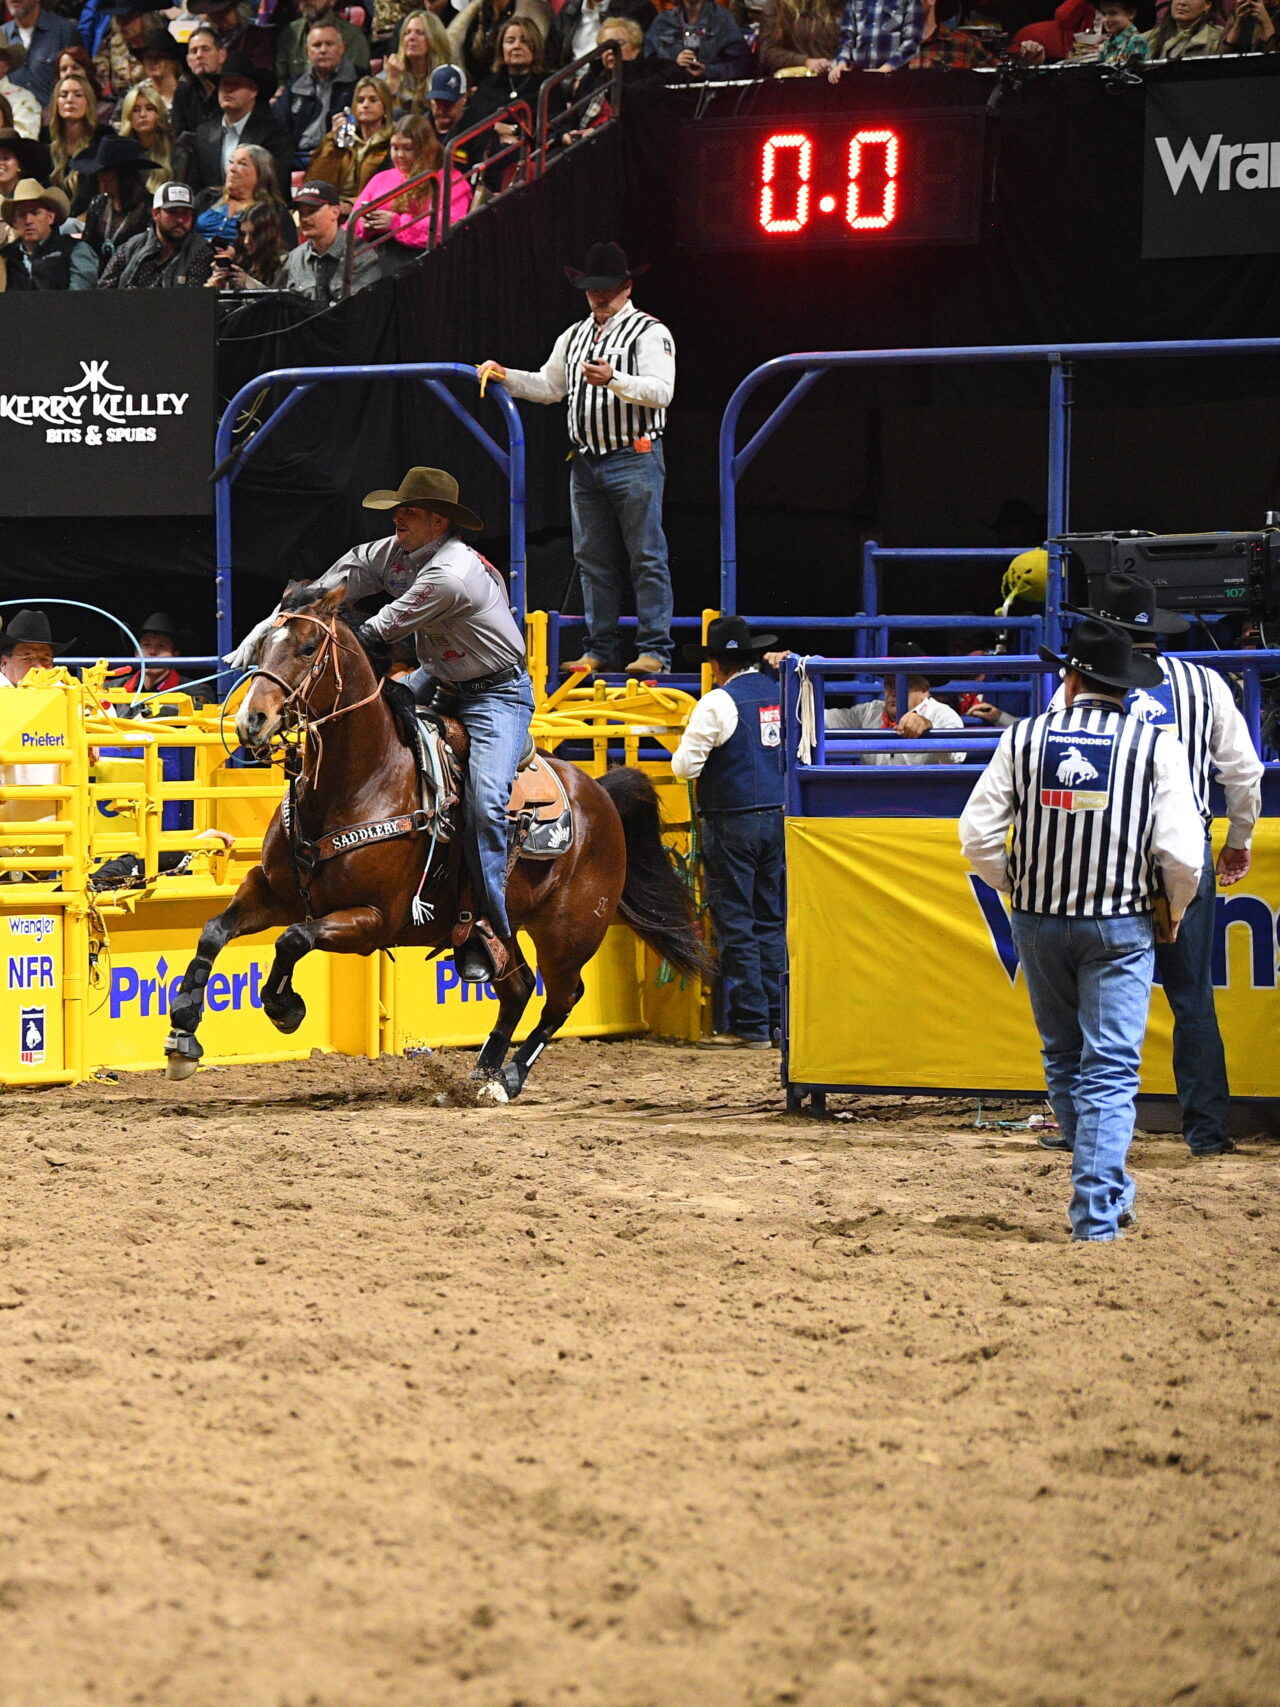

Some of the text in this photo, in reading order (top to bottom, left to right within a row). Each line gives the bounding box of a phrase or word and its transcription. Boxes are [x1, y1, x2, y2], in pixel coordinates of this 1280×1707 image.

[1154, 134, 1280, 196] Wra
[760, 130, 898, 232] 0.0
[0, 393, 189, 425] KERRY KELLEY
[46, 425, 157, 445] BITS & SPURS
[1124, 558, 1136, 573] 2
[1224, 587, 1246, 598] 107
[22, 731, 65, 747] Priefert
[1048, 735, 1112, 746] PRORODEO
[332, 820, 399, 849] SADDLERY
[9, 916, 55, 942] Wrangler
[8, 956, 54, 988] NFR
[110, 955, 263, 1019] Prieert
